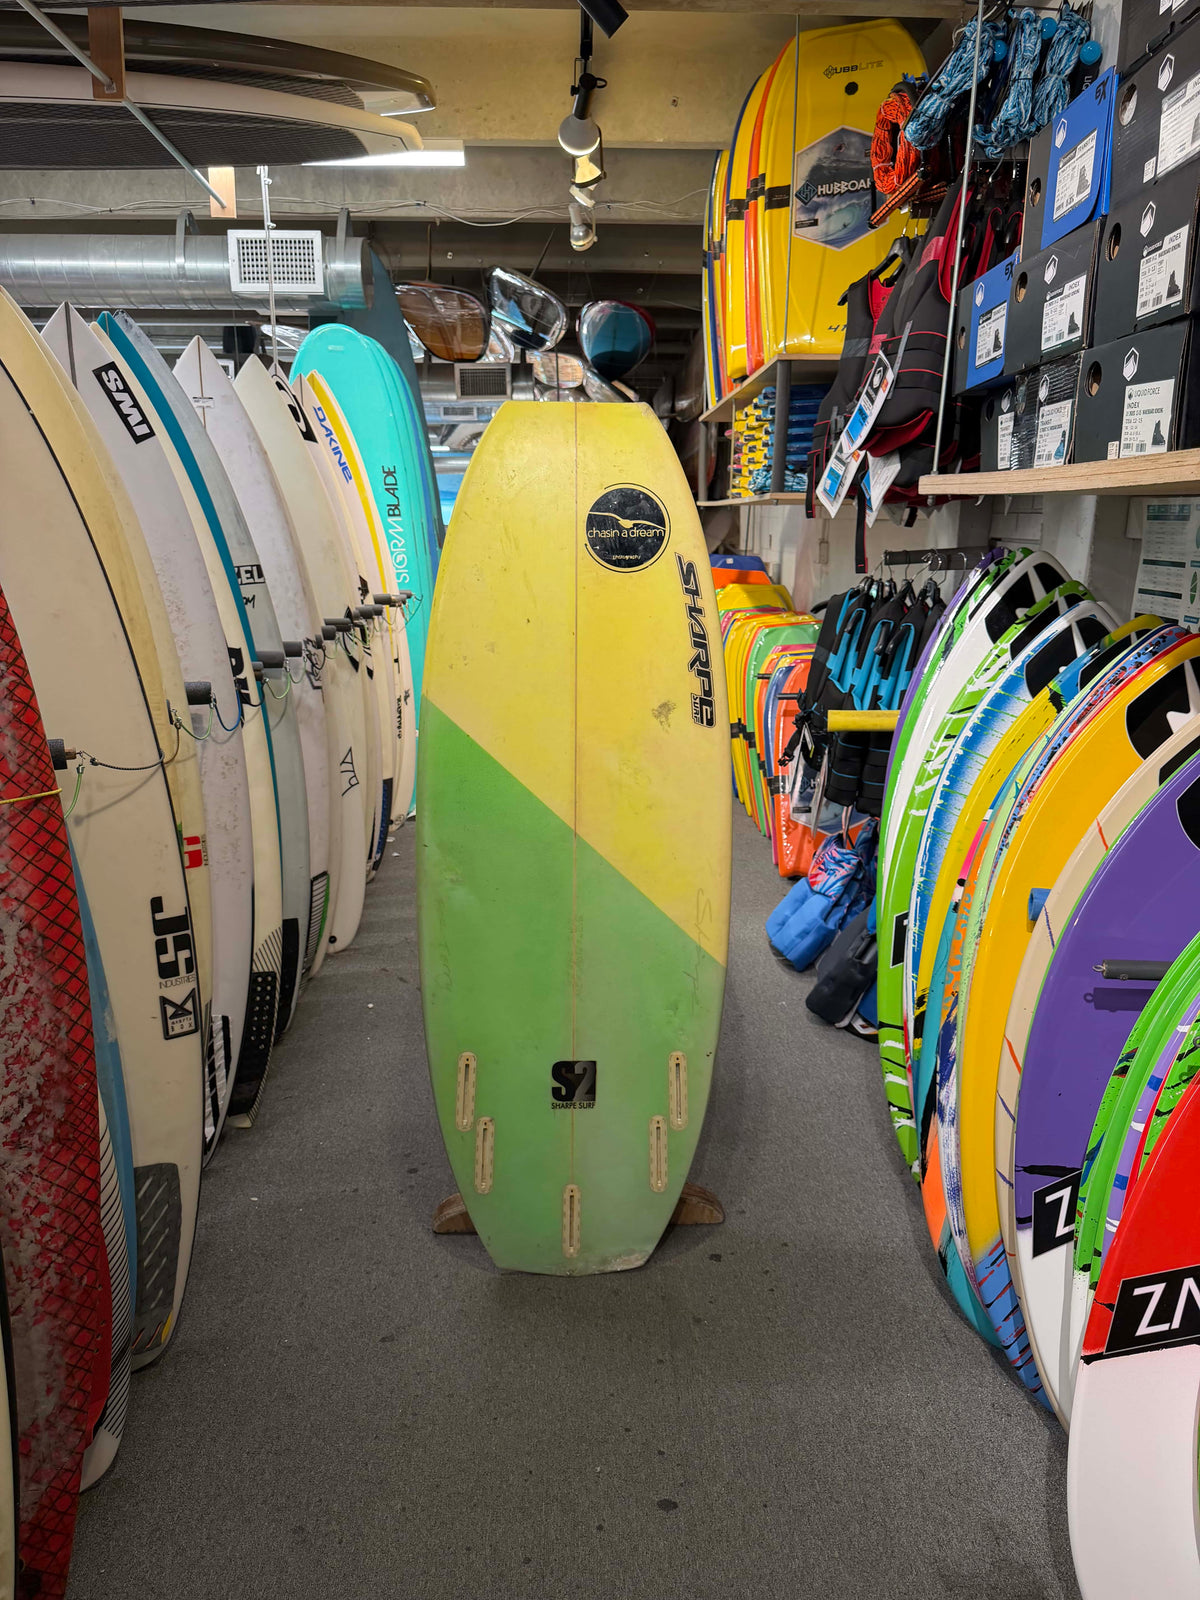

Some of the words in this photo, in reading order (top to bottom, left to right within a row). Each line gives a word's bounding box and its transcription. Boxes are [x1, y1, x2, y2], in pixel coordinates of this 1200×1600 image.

[101, 369, 151, 436] SMI
[313, 405, 353, 484] DAKINE
[588, 526, 620, 538] chasin
[621, 529, 628, 538] a
[629, 526, 665, 538] dream
[675, 552, 716, 729] SHARPE
[691, 692, 700, 724] SURF
[551, 1060, 597, 1102] S2
[551, 1102, 577, 1110] SHARPE
[578, 1101, 596, 1110] SURF
